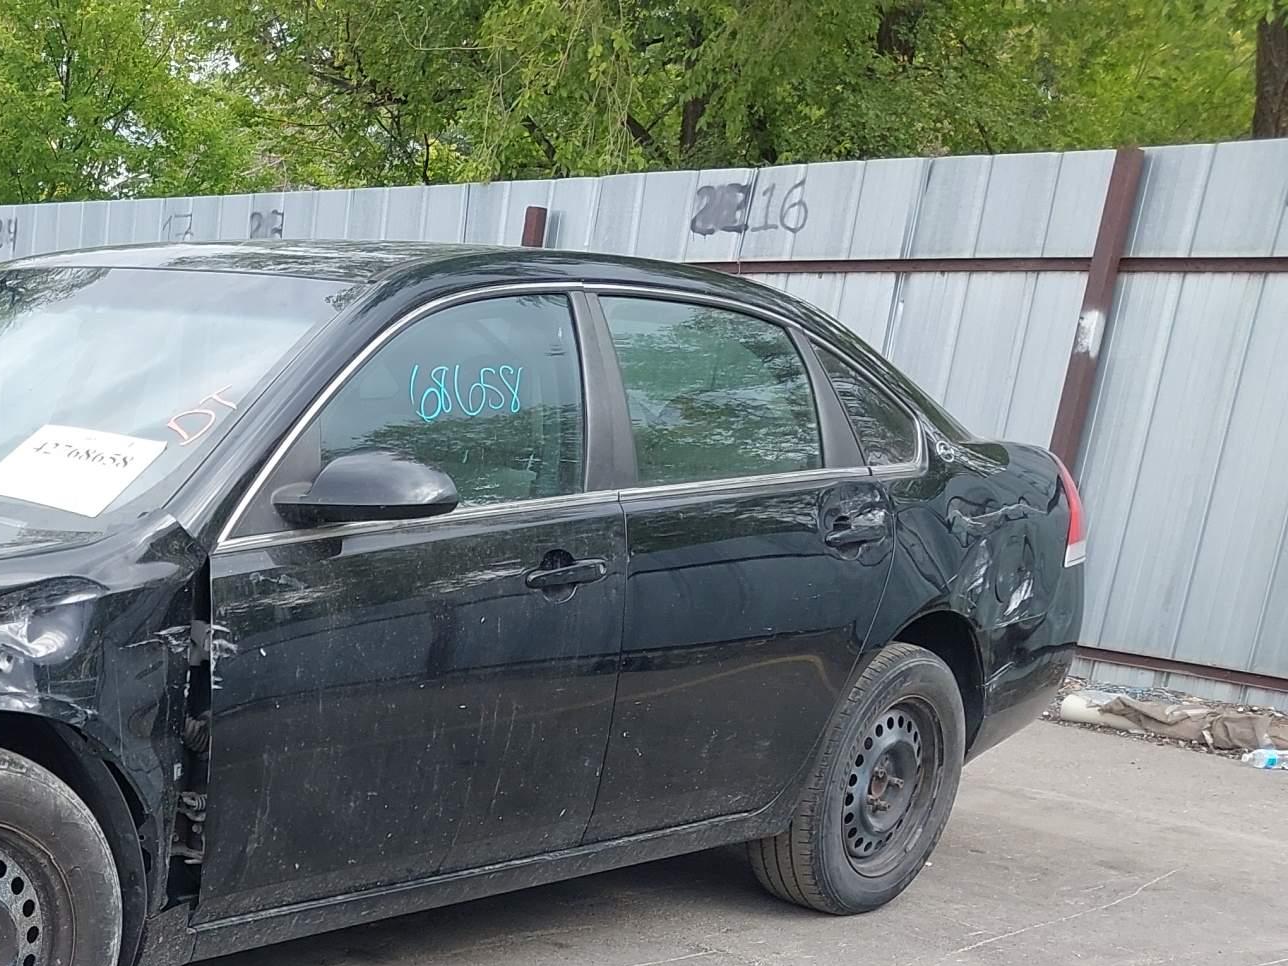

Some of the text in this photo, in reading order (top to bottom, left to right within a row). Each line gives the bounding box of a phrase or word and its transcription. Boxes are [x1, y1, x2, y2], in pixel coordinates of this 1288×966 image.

[750, 178, 808, 233] 16
[410, 364, 524, 422] 68658
[32, 440, 135, 468] 42768658
